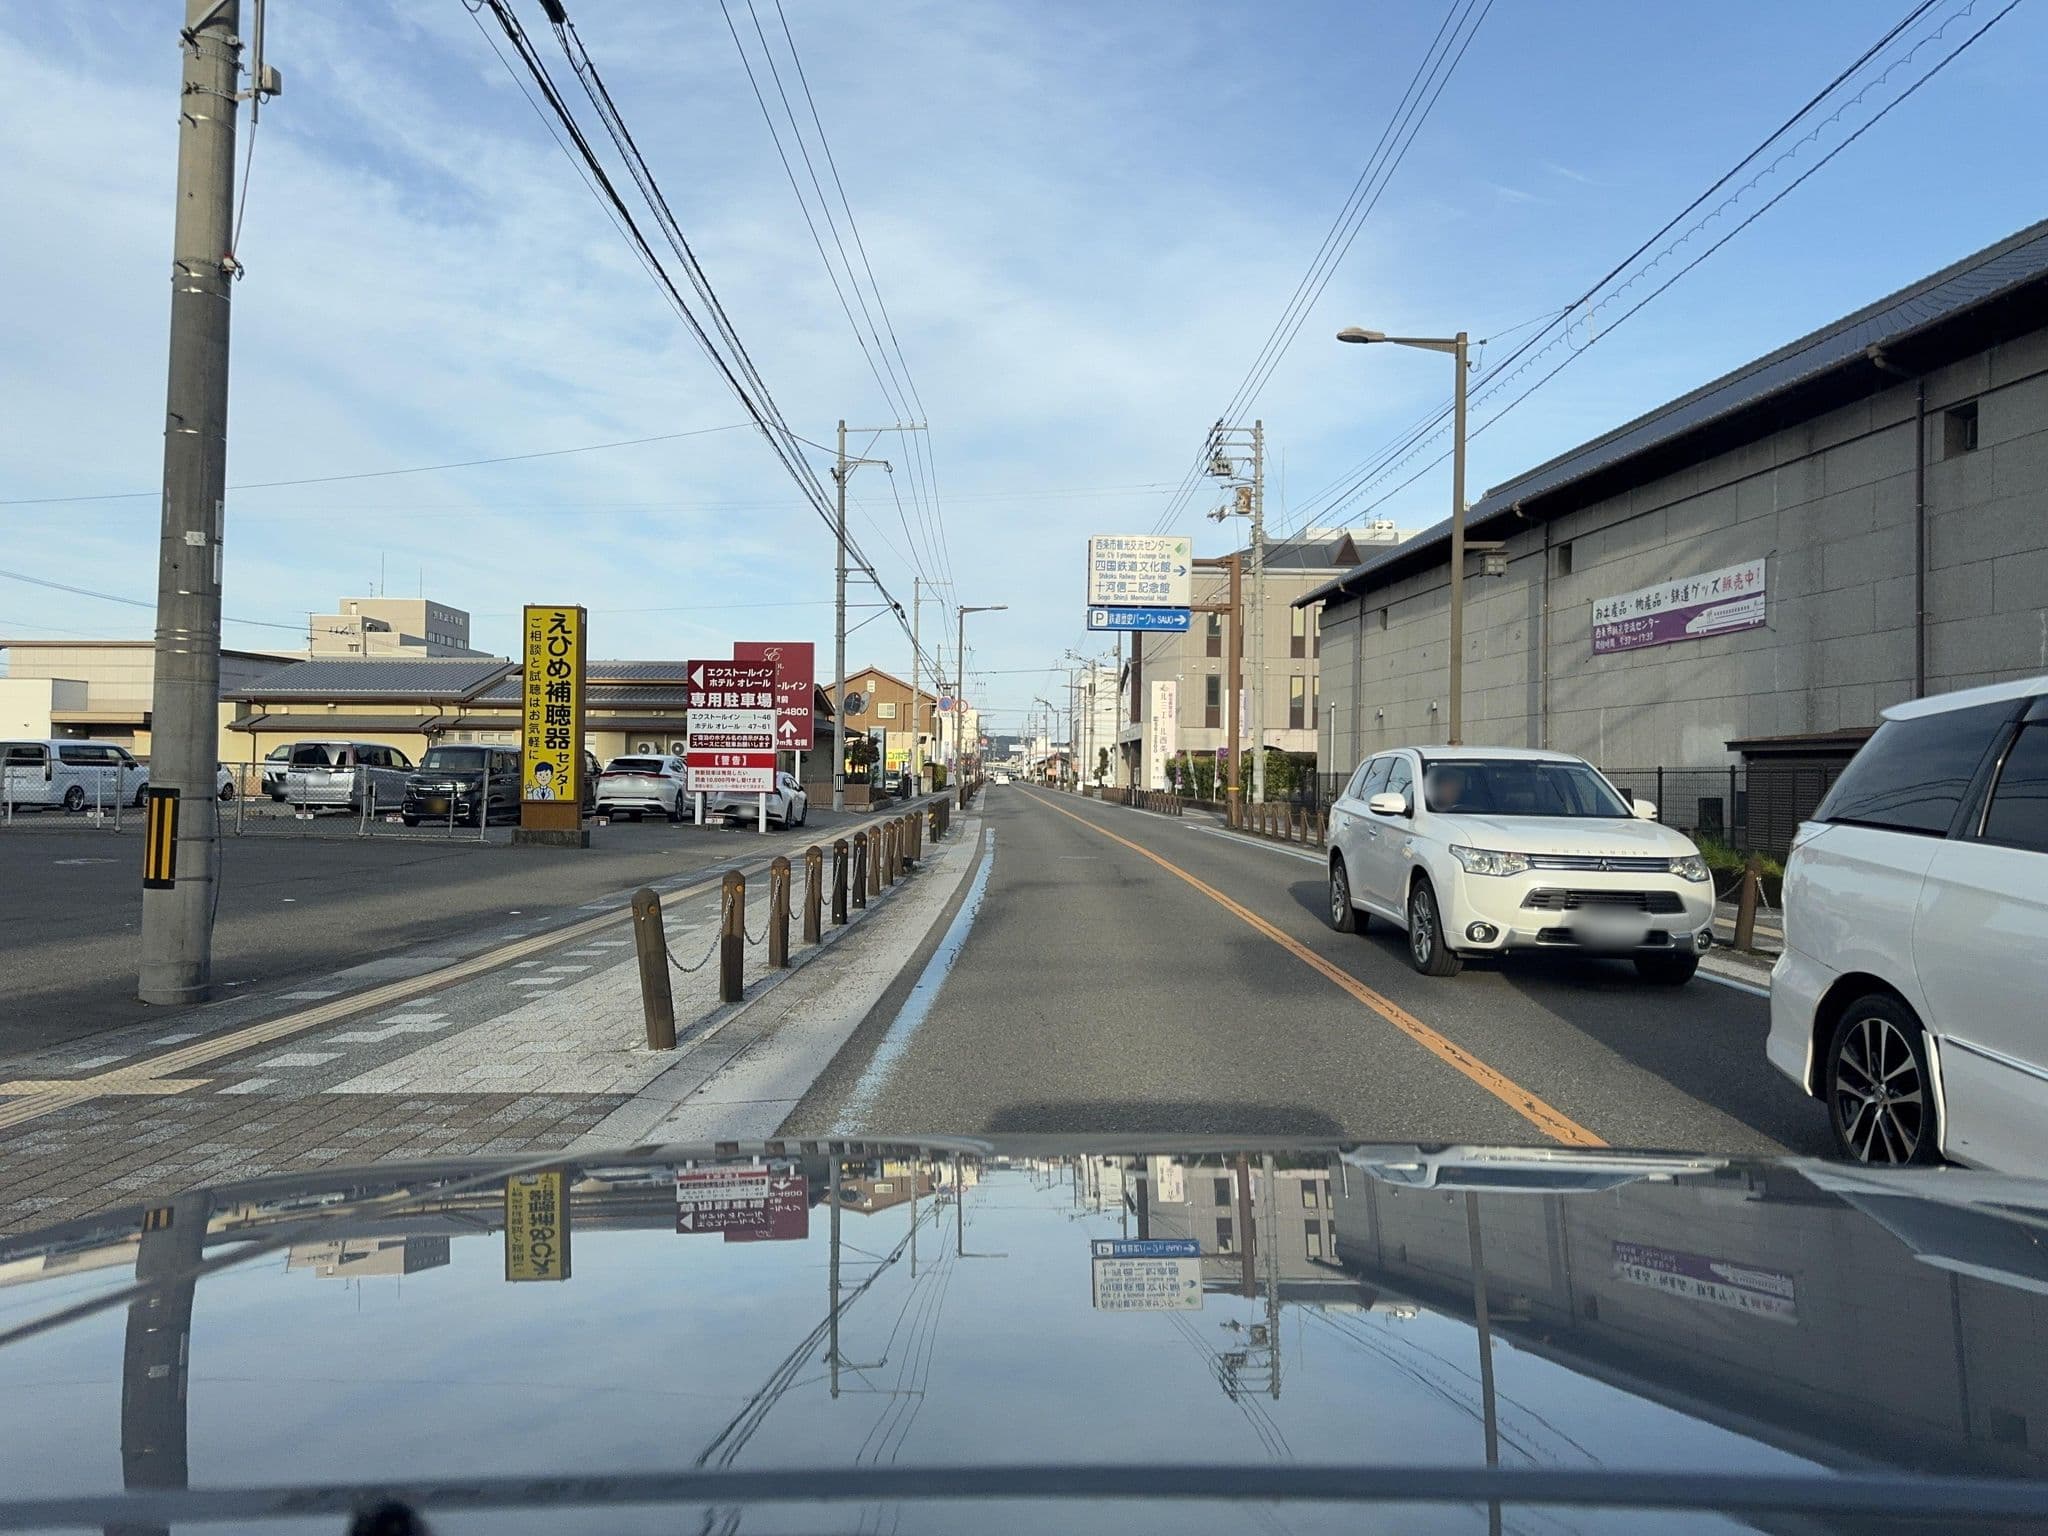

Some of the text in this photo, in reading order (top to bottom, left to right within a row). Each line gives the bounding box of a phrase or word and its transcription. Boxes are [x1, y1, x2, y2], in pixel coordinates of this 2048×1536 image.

[1096, 560, 1171, 573] 四国鉄道文化館
[1096, 581, 1170, 593] 十河信二記念館
[707, 668, 773, 678] エクストールイン
[528, 617, 542, 761] ご相談と試聴はお気軽に
[709, 679, 771, 688] ホテル オレール
[544, 612, 572, 796] えひめ補聴器センター
[690, 692, 772, 708] 専用駐車場
